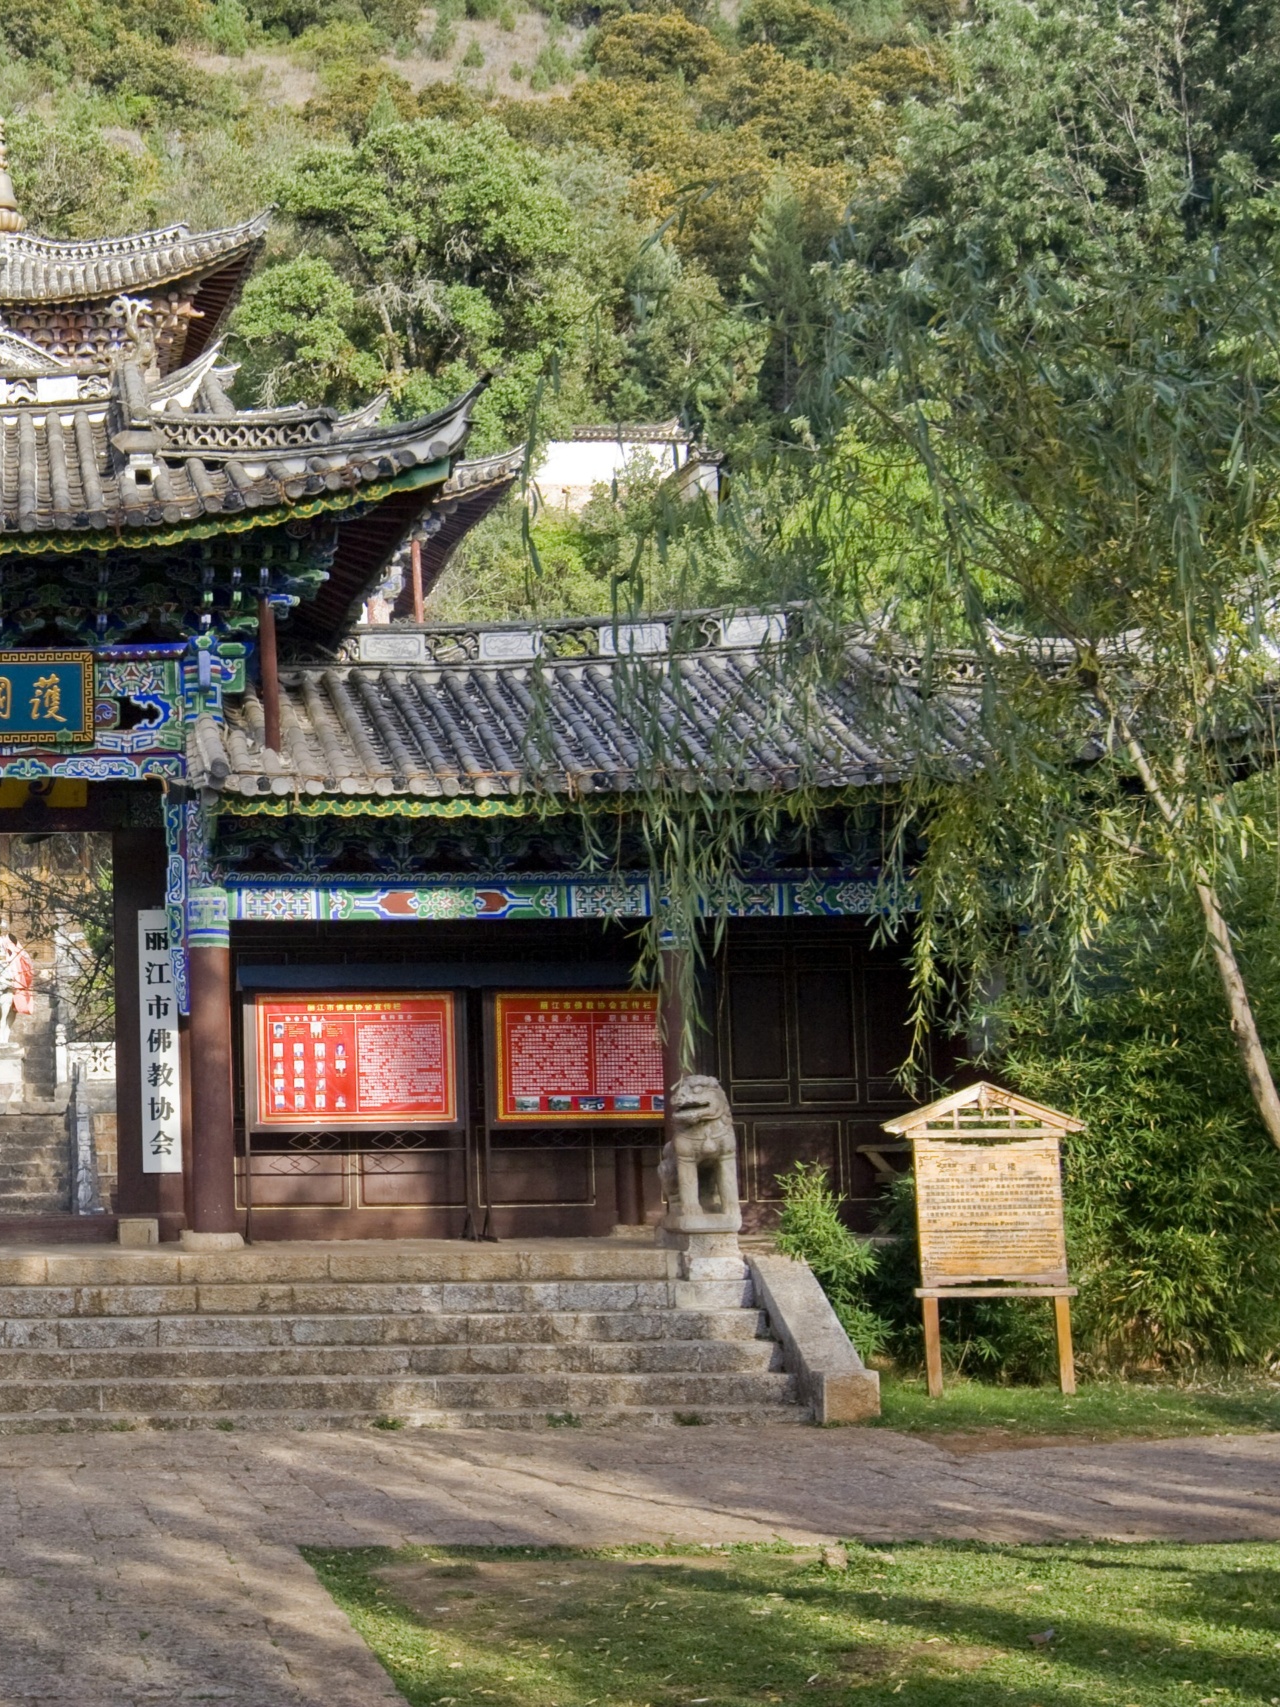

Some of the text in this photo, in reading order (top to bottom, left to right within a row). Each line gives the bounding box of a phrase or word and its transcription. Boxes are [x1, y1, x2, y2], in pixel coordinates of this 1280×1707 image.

[540, 1001, 652, 1010] 丽江市佛教协会宣传栏
[524, 1014, 573, 1022] 佛教简介
[144, 927, 175, 1155] 丽江市佛教协会
